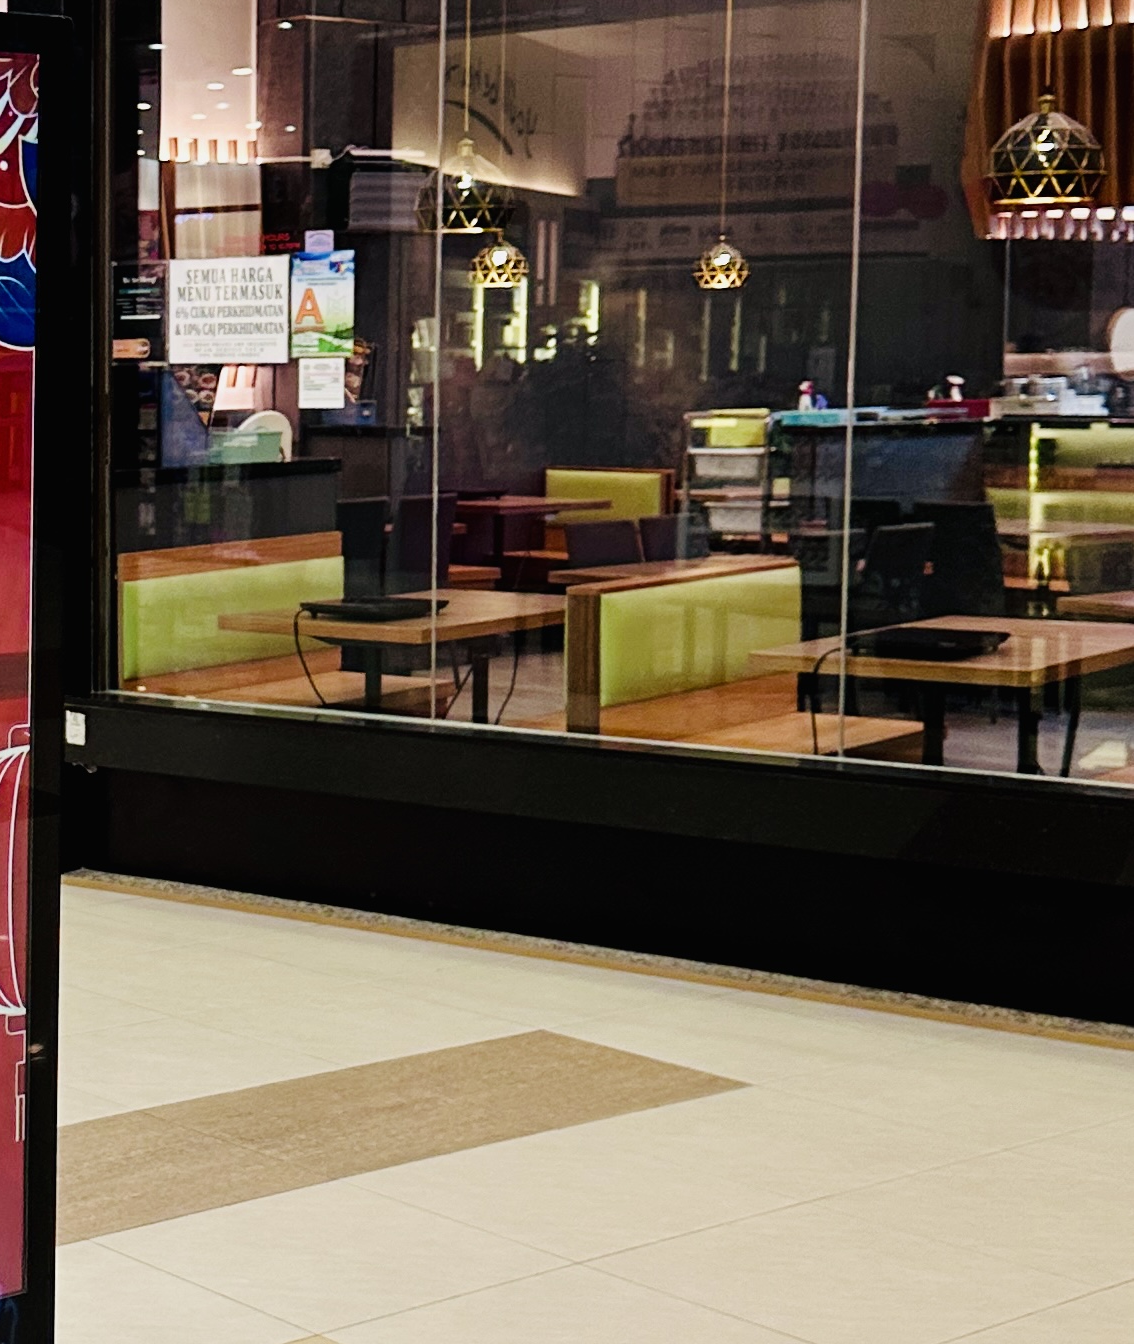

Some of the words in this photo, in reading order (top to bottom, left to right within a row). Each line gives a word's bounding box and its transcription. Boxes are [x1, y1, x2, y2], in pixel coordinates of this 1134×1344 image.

[186, 268, 226, 285] SEMUA
[230, 267, 273, 284] HARGA
[177, 286, 211, 302] MENU
[215, 284, 283, 301] TERMASUK
[217, 304, 284, 318] PERKHIDMATAN
[295, 287, 324, 325] A
[218, 322, 284, 335] PERKHIDMATAN
